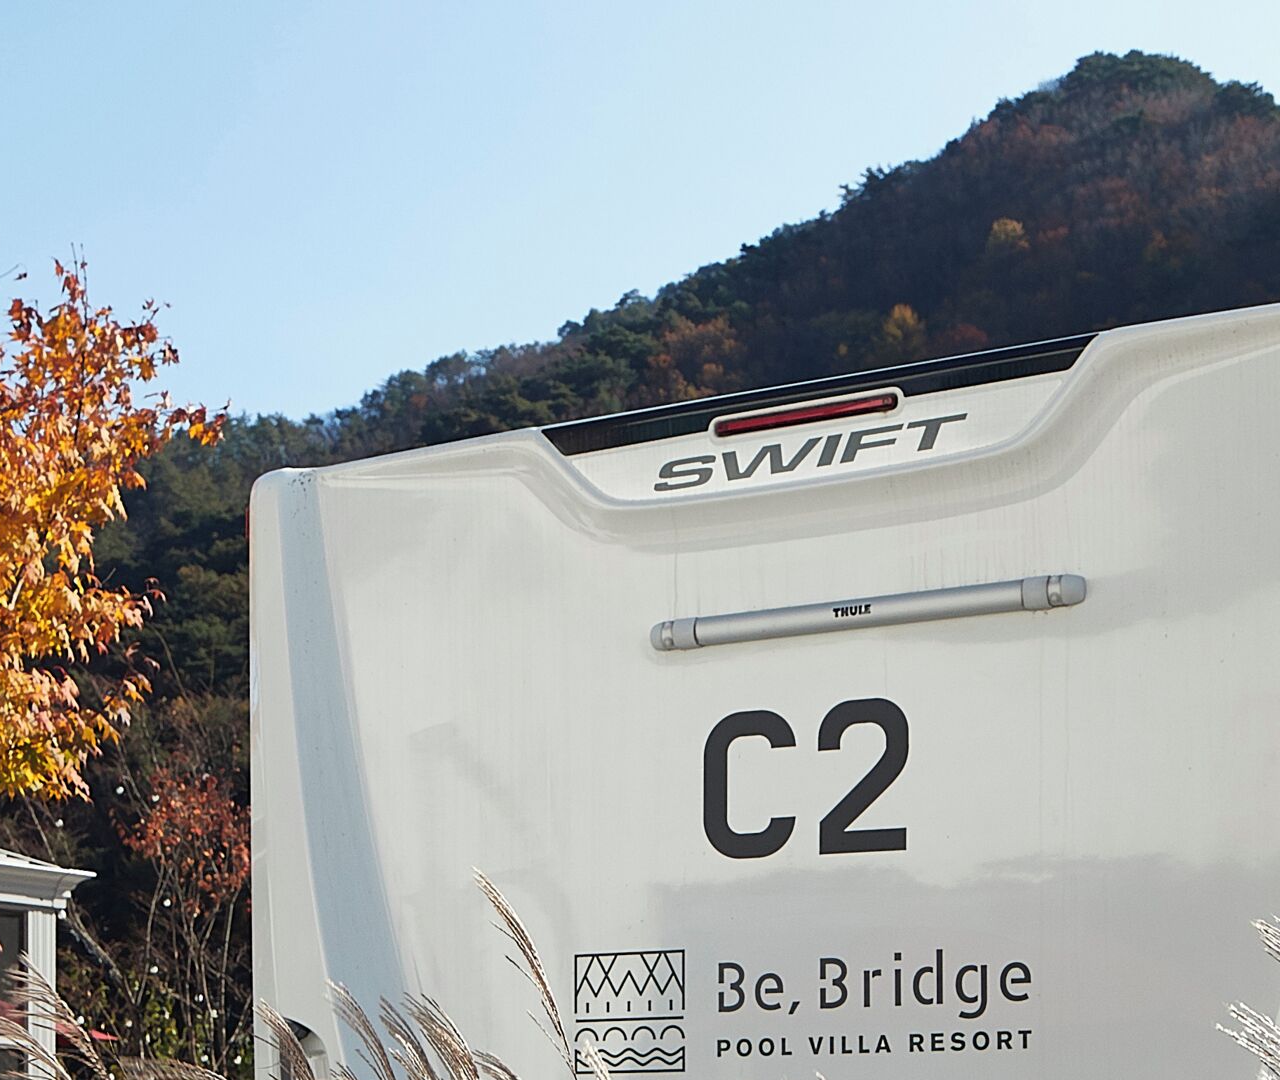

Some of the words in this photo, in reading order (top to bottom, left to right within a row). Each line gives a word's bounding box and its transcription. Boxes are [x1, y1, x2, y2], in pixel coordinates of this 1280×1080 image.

[653, 412, 968, 492] SWIFT
[832, 603, 872, 618] THULE
[703, 697, 910, 860] C2
[717, 962, 802, 1015] Be,
[819, 948, 1033, 1020] Bridge
[716, 1037, 793, 1058] POOL
[808, 1034, 893, 1055] VILLA
[909, 1029, 1034, 1053] RESORT
